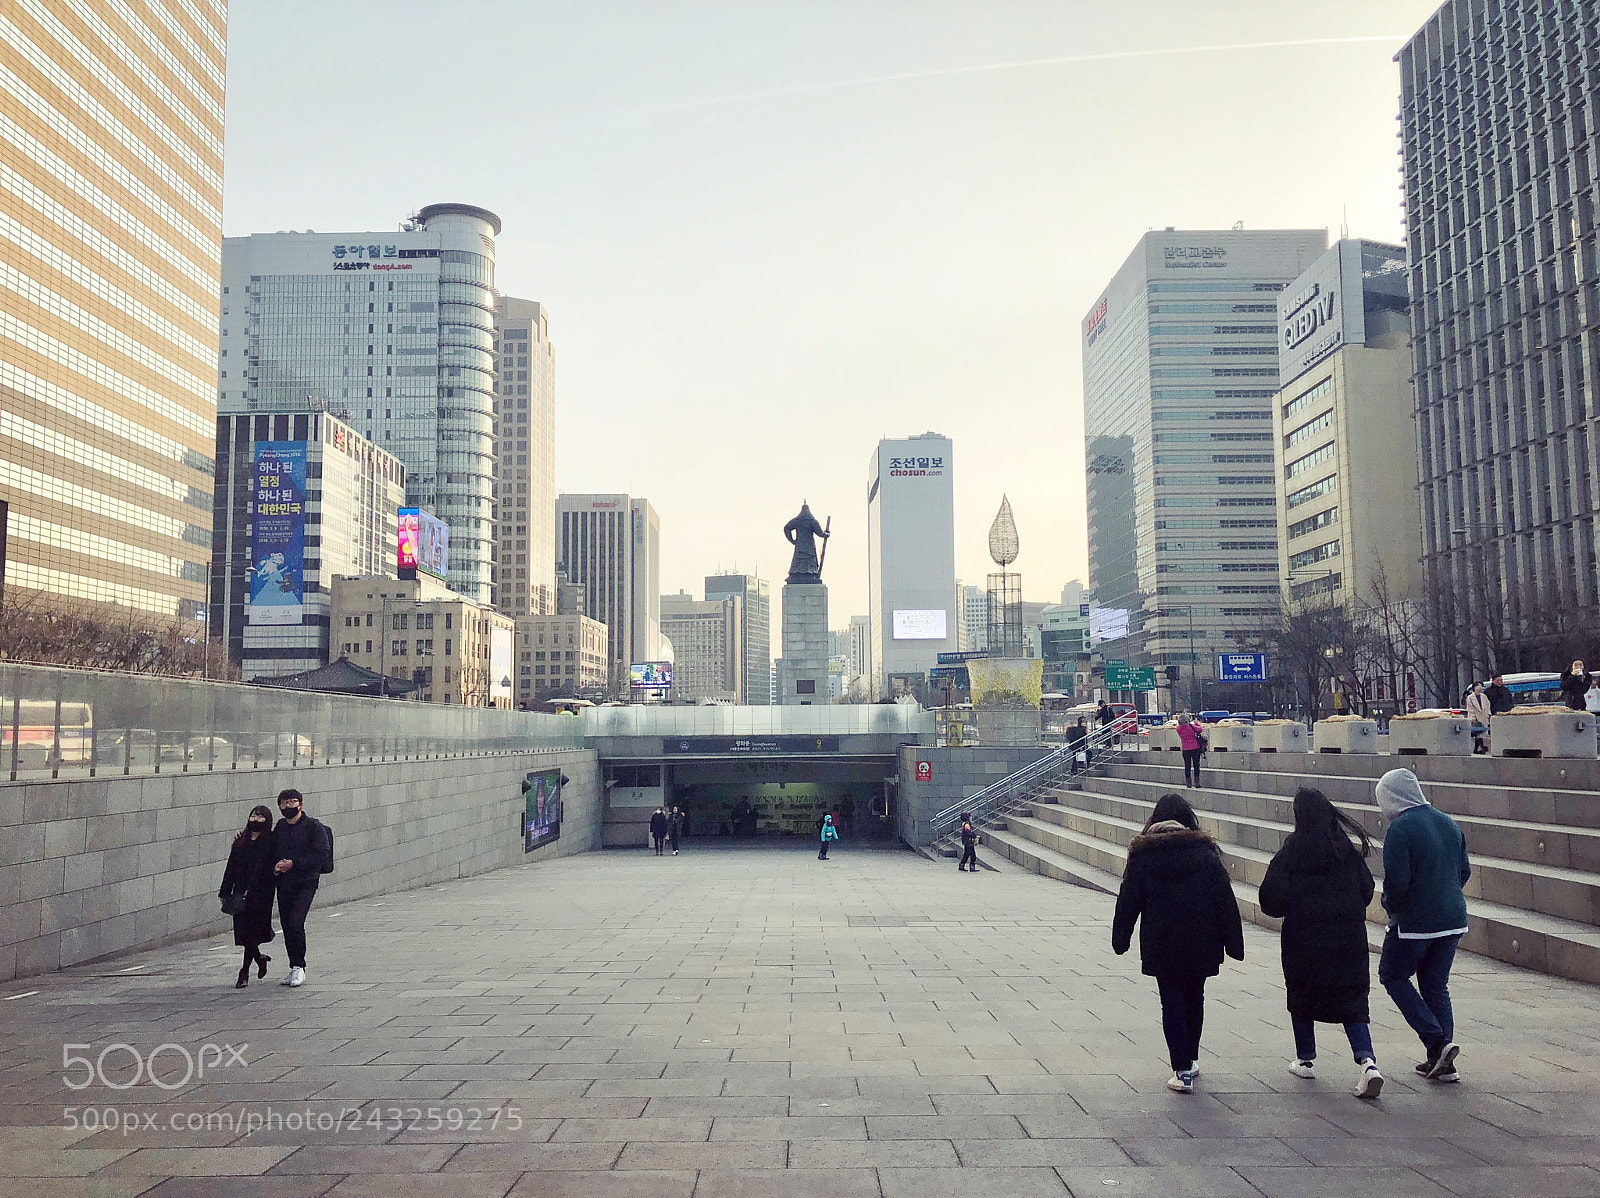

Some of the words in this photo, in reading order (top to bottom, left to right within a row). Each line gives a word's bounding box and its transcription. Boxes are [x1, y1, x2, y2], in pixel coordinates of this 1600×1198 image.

[332, 245, 398, 259] 동아일보
[259, 461, 280, 474] 하나
[282, 461, 293, 474] 된
[889, 457, 945, 469] 조선일보
[890, 469, 943, 477] chosun.com
[259, 475, 280, 488] 열정
[258, 489, 280, 502] 하나
[281, 489, 292, 502] 된
[257, 502, 302, 516] 대한민국
[816, 739, 822, 747] 9
